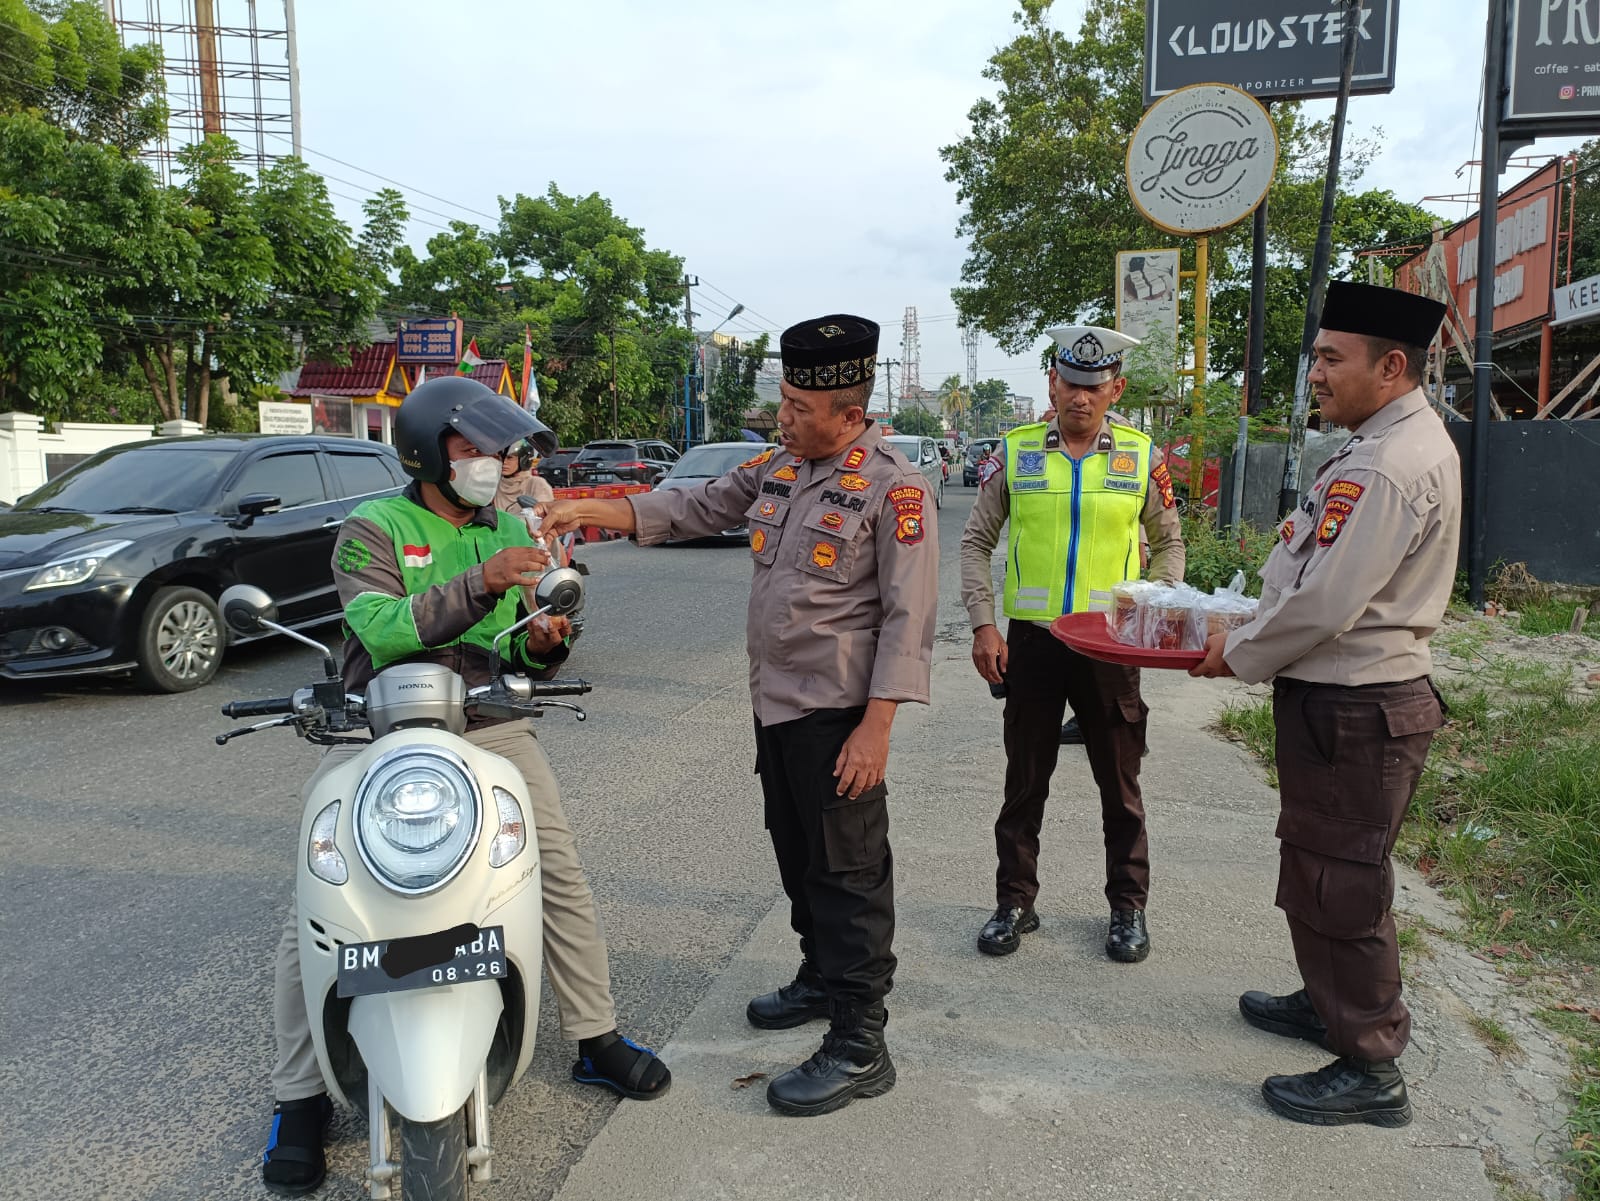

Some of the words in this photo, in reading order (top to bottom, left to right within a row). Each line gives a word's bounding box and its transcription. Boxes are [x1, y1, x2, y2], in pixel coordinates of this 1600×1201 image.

[1534, 63, 1569, 75] coffee
[1231, 78, 1305, 91] APORIZER
[820, 490, 867, 512] POLRI
[898, 503, 920, 511] RIAU
[398, 683, 434, 691] HONDA
[344, 946, 379, 970] BM
[432, 967, 457, 982] 08
[476, 961, 500, 977] 26
